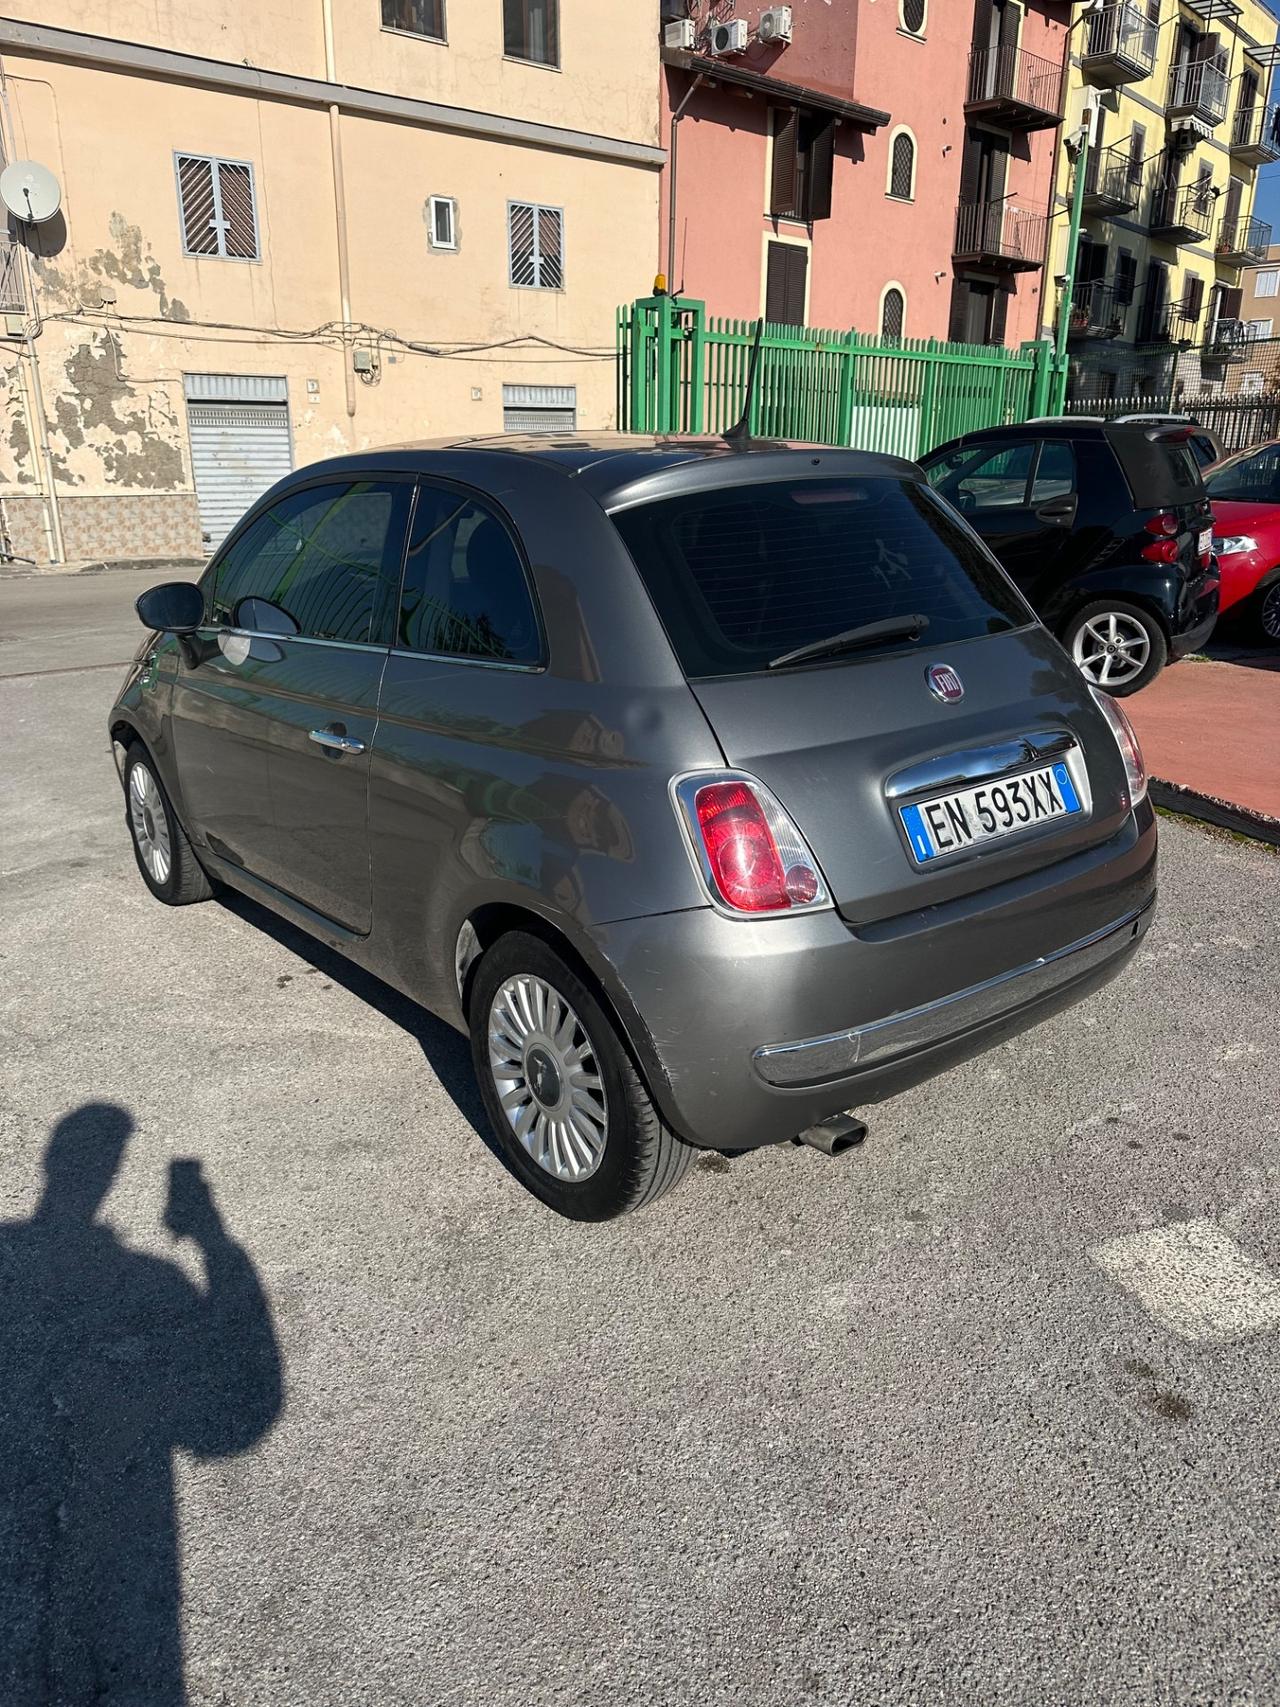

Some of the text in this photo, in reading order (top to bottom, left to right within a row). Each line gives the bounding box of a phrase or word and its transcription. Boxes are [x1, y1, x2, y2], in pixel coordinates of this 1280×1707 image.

[935, 671, 959, 692] FIAT
[925, 772, 1062, 849] EN 593XX
